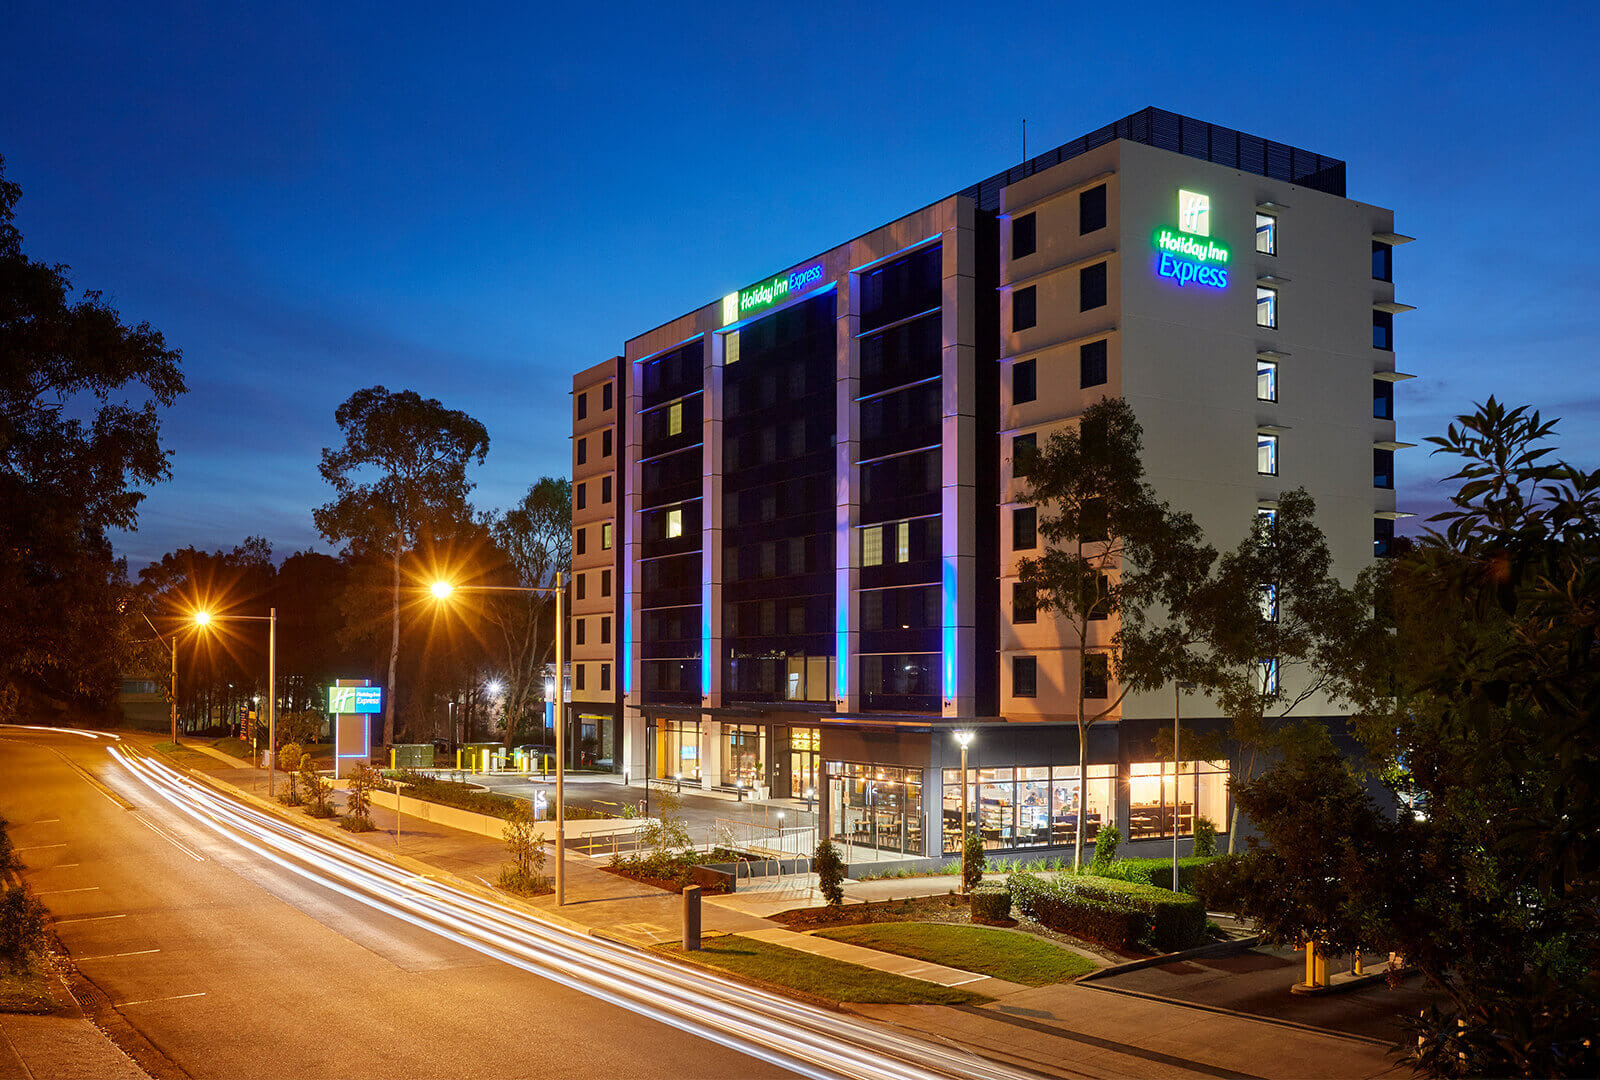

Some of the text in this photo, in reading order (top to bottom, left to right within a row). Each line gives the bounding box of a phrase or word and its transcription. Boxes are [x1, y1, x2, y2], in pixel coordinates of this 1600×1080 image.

[1159, 230, 1228, 262] Holiday Inn
[741, 265, 821, 311] Holiday Inn Express
[1159, 252, 1228, 288] Express
